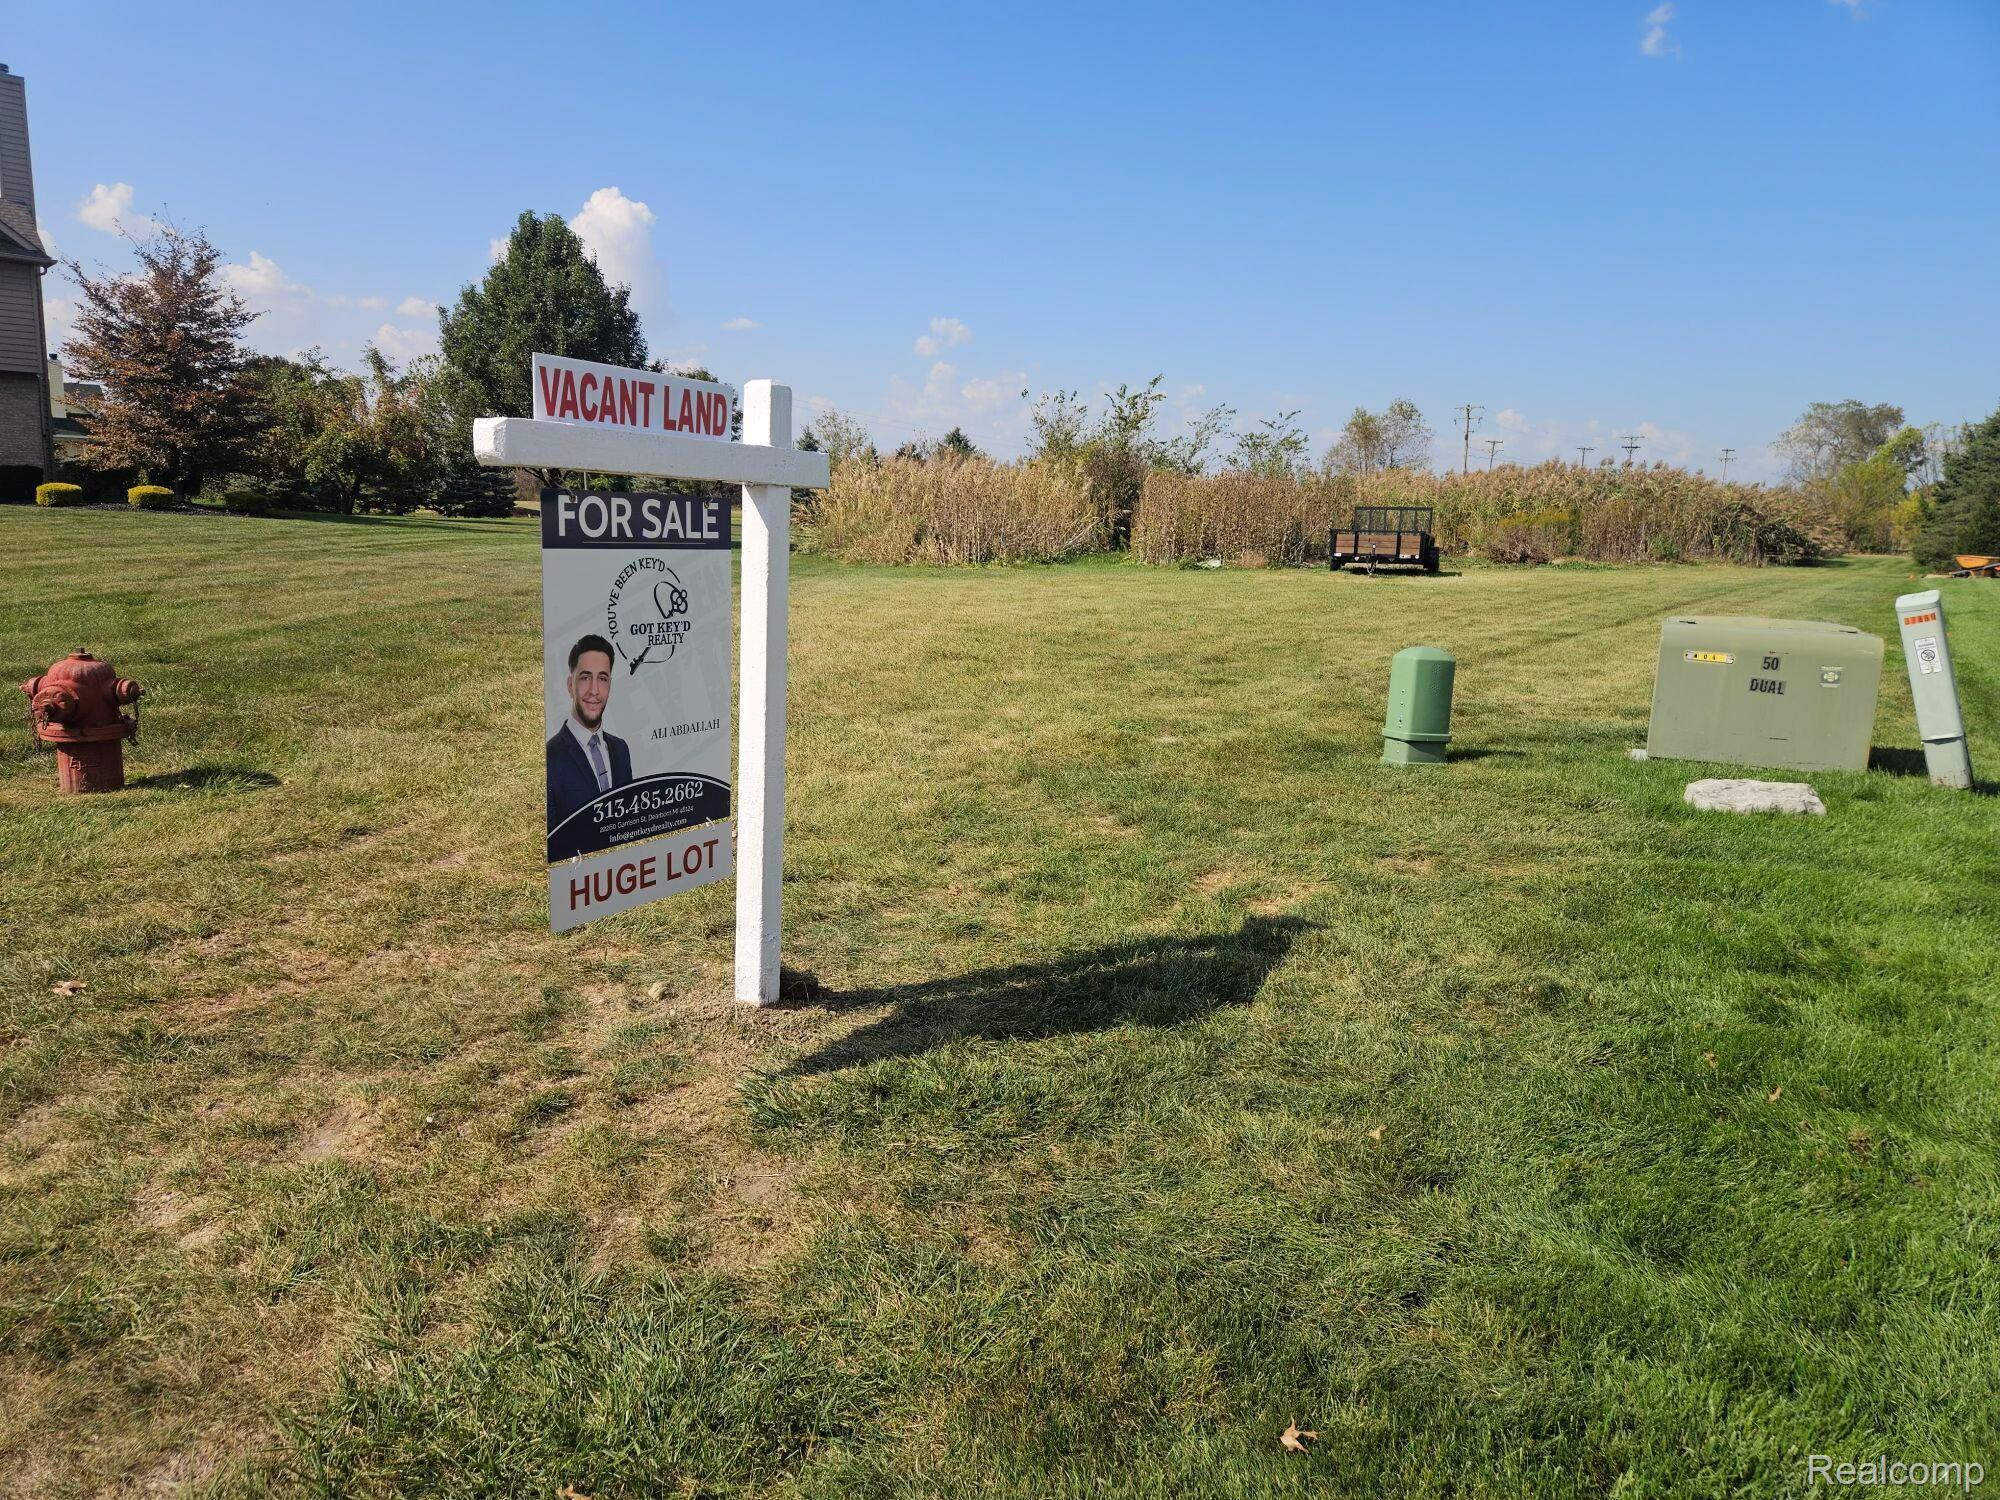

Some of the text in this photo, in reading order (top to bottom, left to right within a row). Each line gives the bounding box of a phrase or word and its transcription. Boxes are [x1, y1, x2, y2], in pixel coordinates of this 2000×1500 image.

[539, 366, 728, 437] VACANT LAND
[558, 494, 719, 539] FOR SALE
[607, 557, 665, 639] YOU'VE BEEN KEY'D
[630, 620, 691, 635] GOT KEY'D
[648, 632, 685, 646] REALTY
[1763, 656, 1779, 671] 50
[1750, 678, 1785, 695] DUAL
[651, 718, 720, 740] ALI ABDALLAH
[593, 781, 704, 823] 313.485.2662
[609, 818, 687, 843] info@gotkeydrealty.com
[617, 818, 640, 829] Garrison
[570, 838, 719, 910] HUGE LOT
